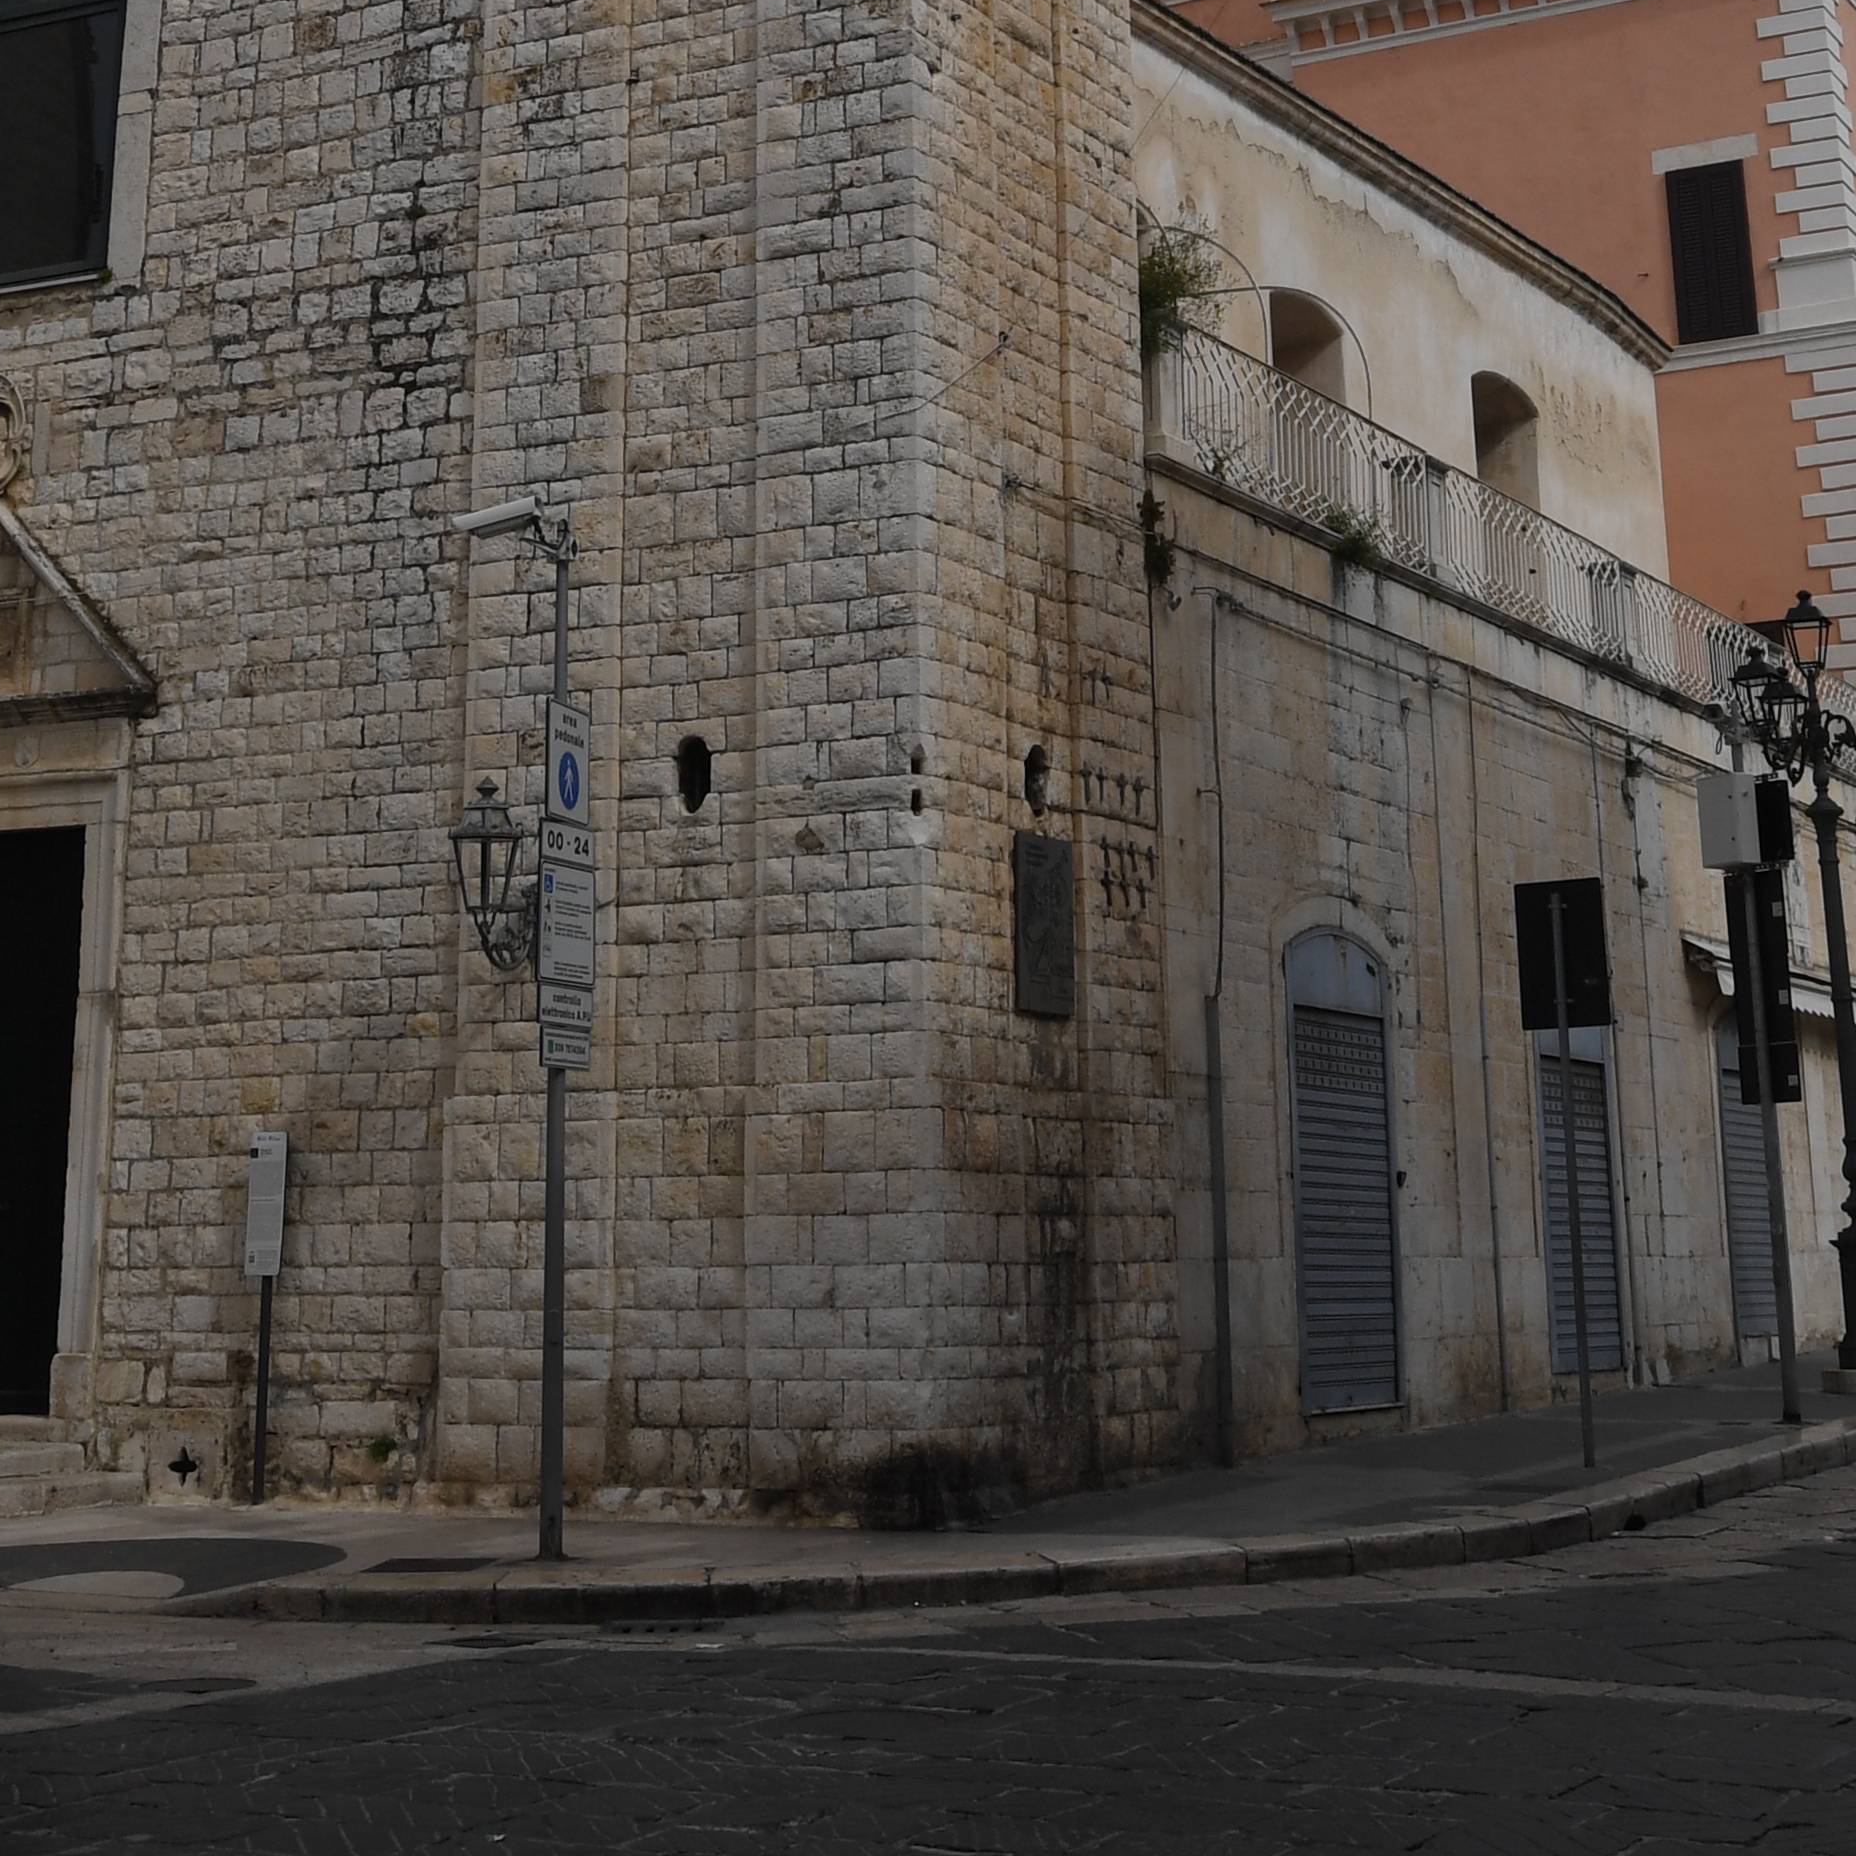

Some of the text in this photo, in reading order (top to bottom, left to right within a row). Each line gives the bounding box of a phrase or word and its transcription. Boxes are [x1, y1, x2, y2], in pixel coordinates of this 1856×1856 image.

[562, 713, 577, 729] area
[554, 728, 585, 749] pedonale
[547, 830, 563, 850] 00
[574, 836, 589, 856] 24
